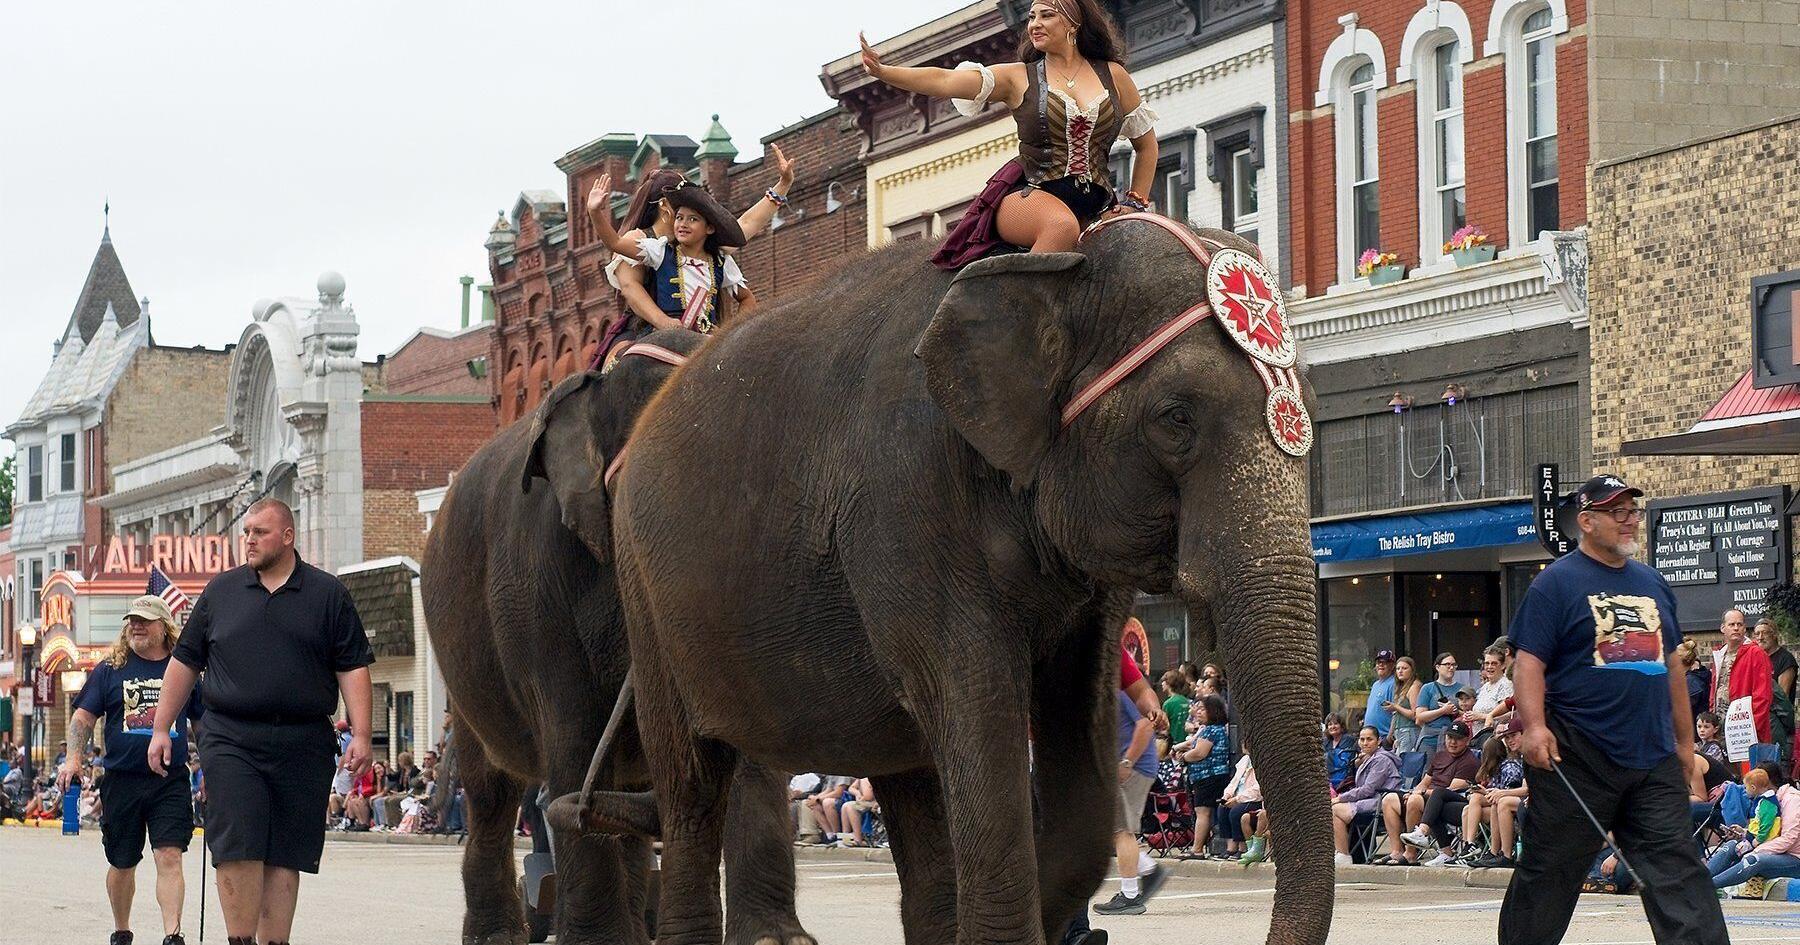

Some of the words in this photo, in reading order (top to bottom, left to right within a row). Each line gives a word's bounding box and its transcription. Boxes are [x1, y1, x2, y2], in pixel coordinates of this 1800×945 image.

[1543, 468, 1552, 501] EAT
[1662, 510, 1702, 523] ETCETERA
[1707, 507, 1725, 518] BLH
[1730, 505, 1752, 516] Green
[1754, 502, 1771, 513] Vine
[1518, 525, 1536, 535] 608-44
[1544, 508, 1567, 552] HERE
[1661, 524, 1685, 539] Tracy's
[1686, 524, 1706, 536] Chair
[1713, 523, 1722, 533] It's
[1723, 522, 1732, 532] All
[1733, 520, 1750, 531] About
[1764, 517, 1778, 530] Yoga
[1379, 538, 1392, 550] The
[1393, 535, 1414, 549] Relish
[1416, 534, 1431, 548] Tray
[1433, 531, 1454, 544] Bistro
[1656, 542, 1673, 555] Jerry's
[1675, 541, 1688, 552] Cash
[1689, 539, 1710, 553] Register
[1722, 537, 1732, 549] IN
[1736, 535, 1764, 548] Courage
[1312, 548, 1324, 556] ourth
[1728, 552, 1745, 564] Satori
[1746, 551, 1764, 562] House
[1656, 555, 1699, 568] International
[1676, 570, 1690, 581] Hall
[1691, 569, 1698, 580] of
[1699, 569, 1717, 579] Fame
[1735, 566, 1759, 578] Recovery
[1734, 589, 1757, 601] RENTAL
[1164, 627, 1180, 641] OPEN
[1728, 711, 1750, 721] PARKING
